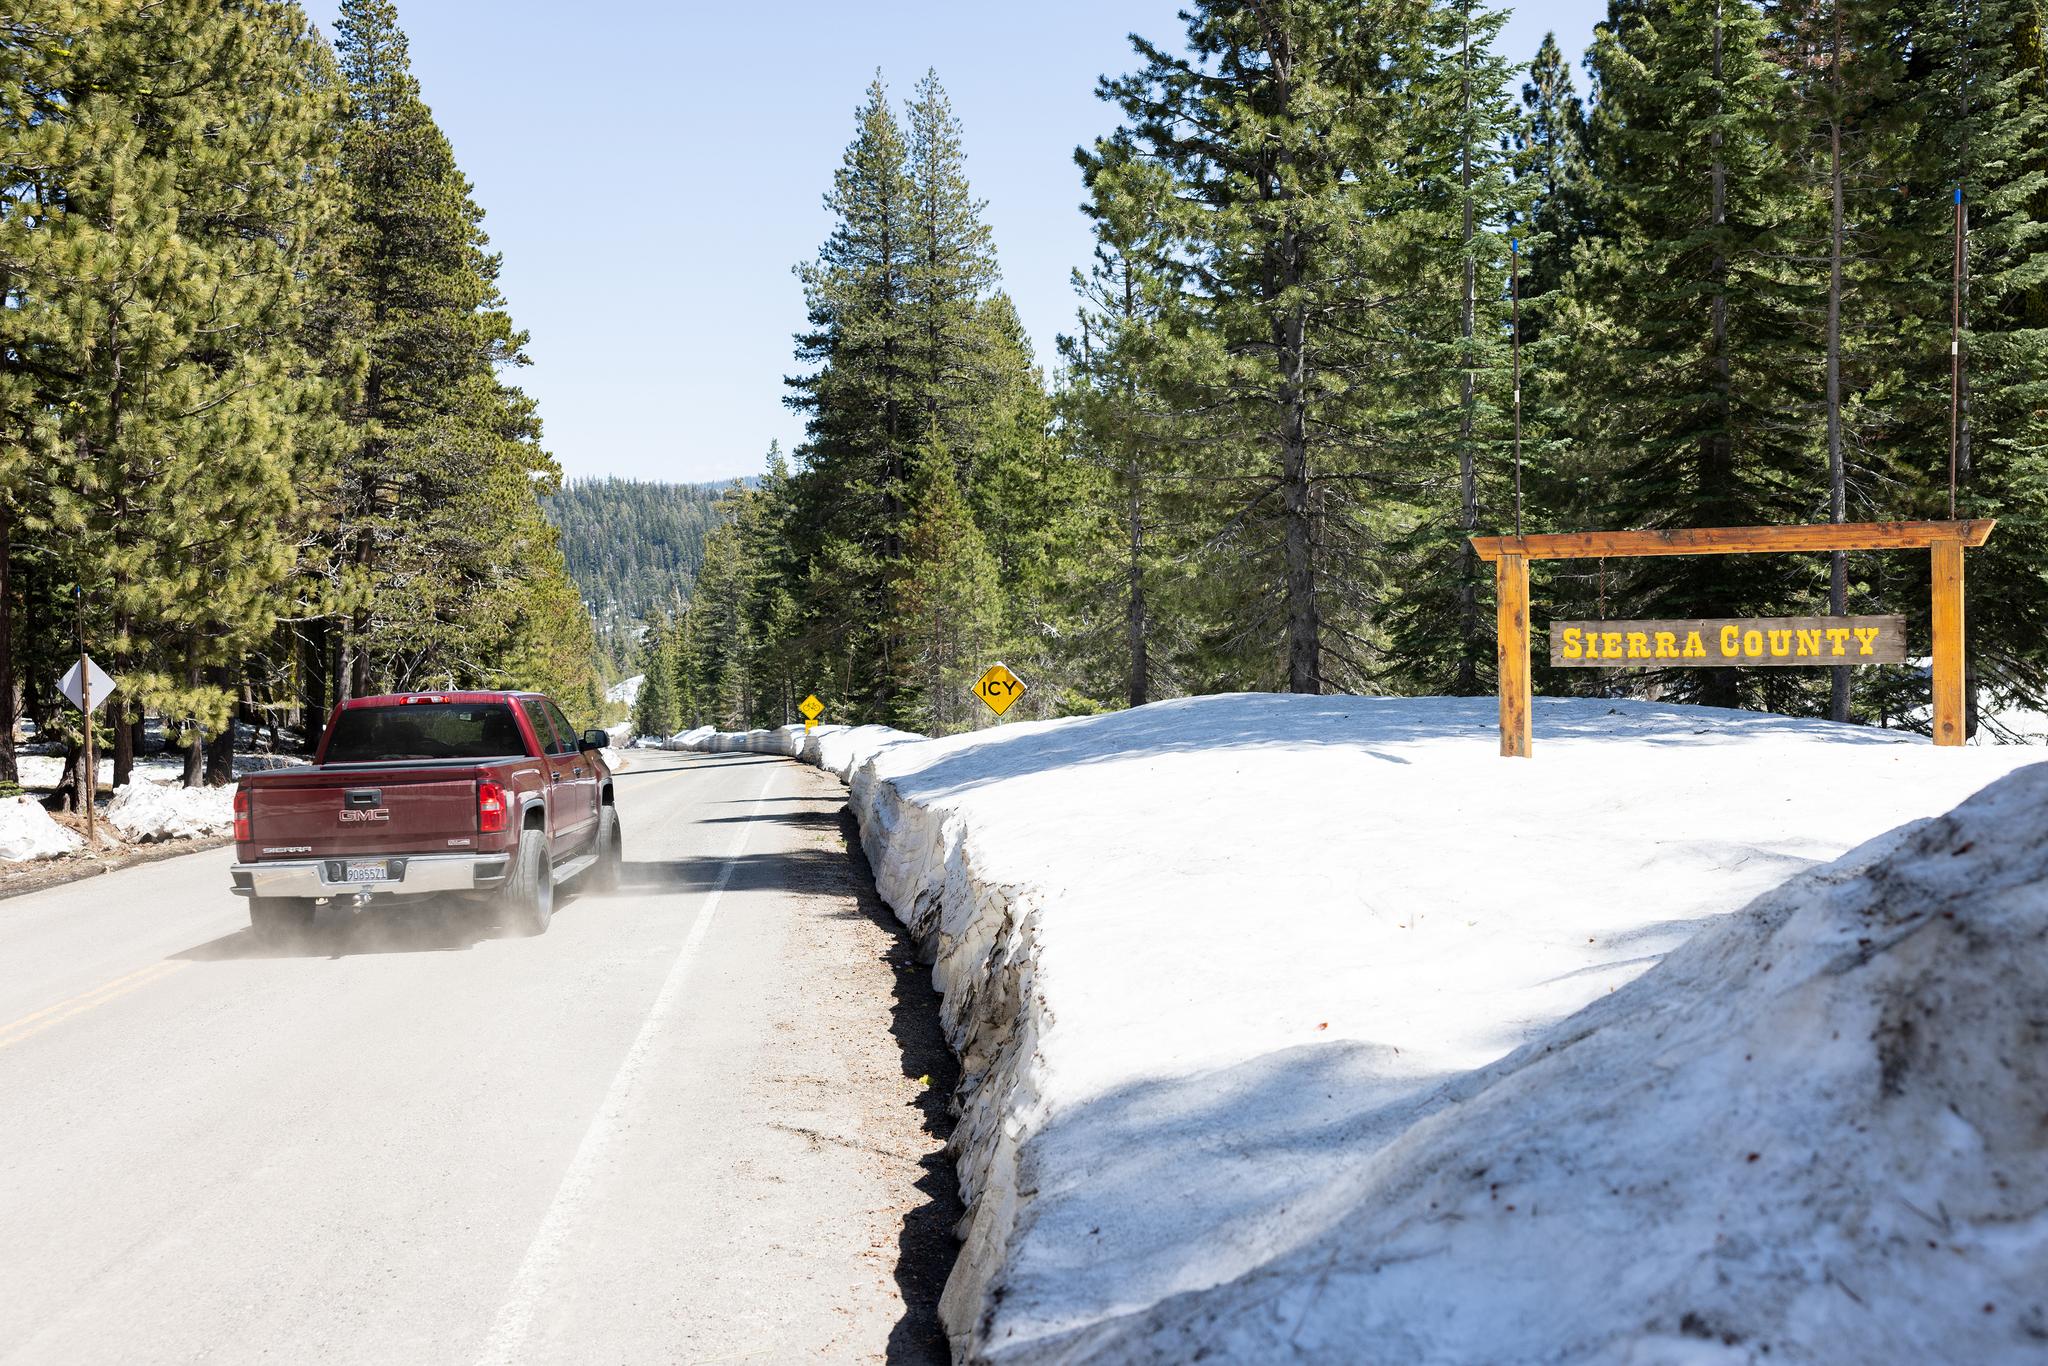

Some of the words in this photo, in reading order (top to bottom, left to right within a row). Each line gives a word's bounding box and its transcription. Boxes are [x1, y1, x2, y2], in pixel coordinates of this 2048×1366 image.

[1563, 627, 1707, 659] SIERRA
[1720, 624, 1879, 657] COUNTY
[982, 680, 1017, 696] ICY
[339, 808, 389, 821] GMC
[263, 846, 312, 854] SIERRA
